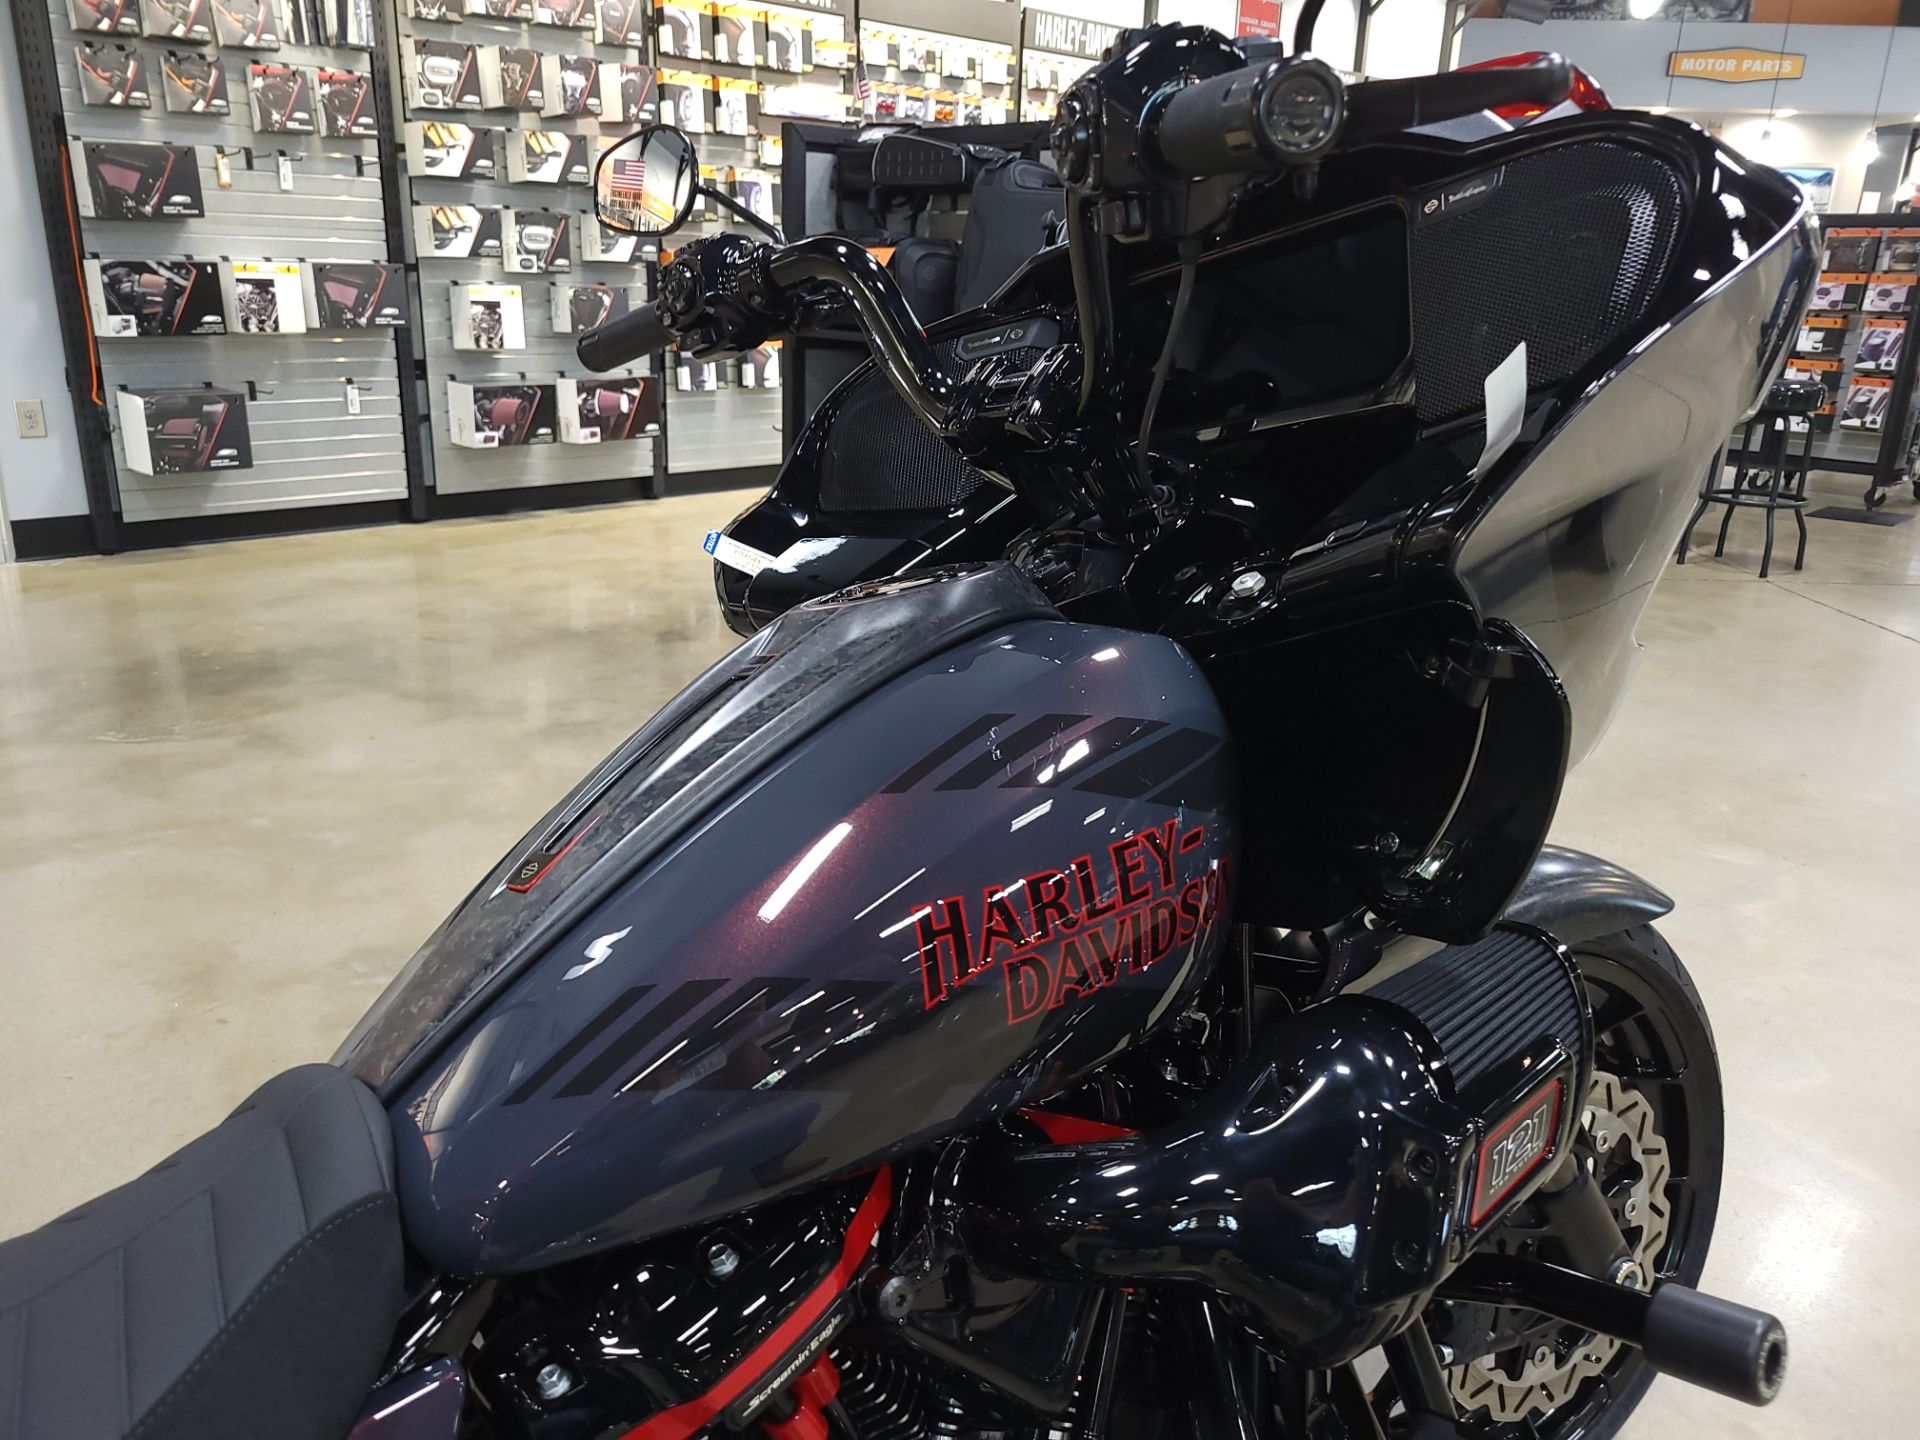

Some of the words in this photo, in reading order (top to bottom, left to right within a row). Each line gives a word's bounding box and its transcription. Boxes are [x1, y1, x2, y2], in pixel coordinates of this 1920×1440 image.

[1681, 58, 1737, 71] MOTOR
[1742, 60, 1793, 73] PARTS
[910, 818, 1204, 1010] HARLEY-
[1492, 1104, 1547, 1186] 121
[742, 1345, 811, 1417] Screamin'
[810, 1313, 844, 1351] Eagle
